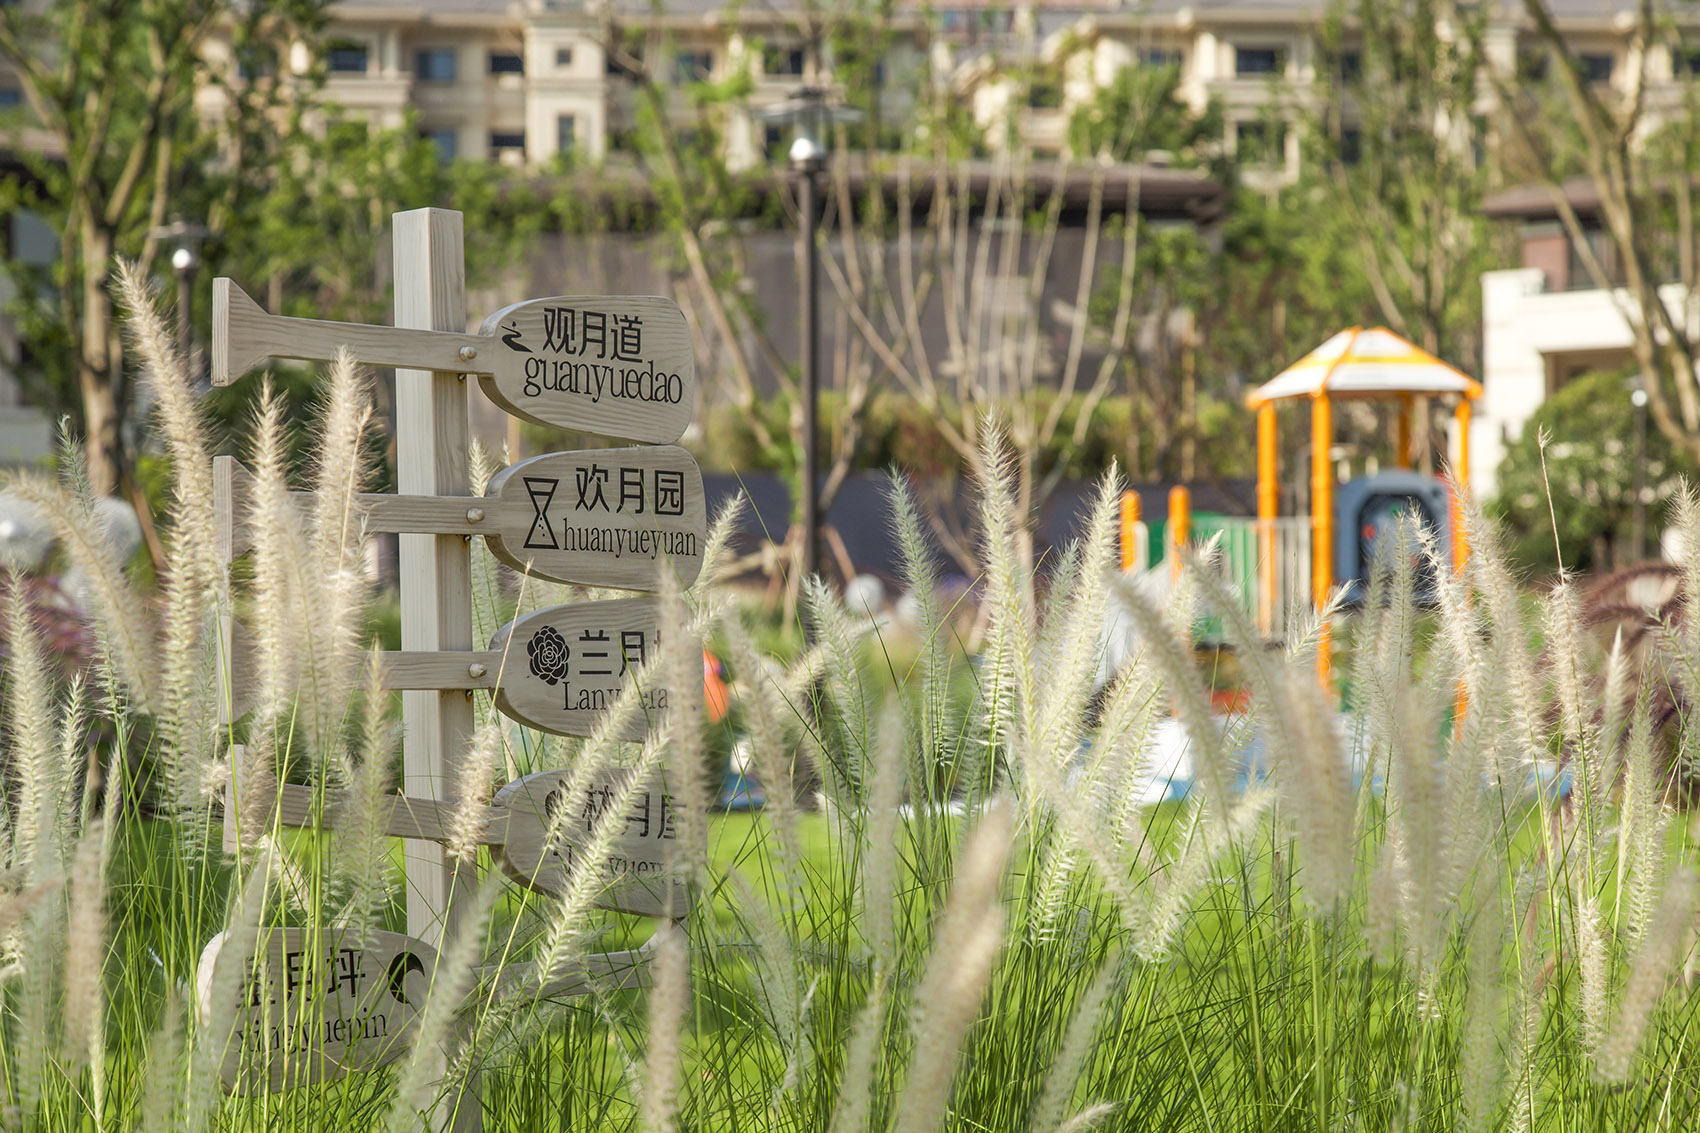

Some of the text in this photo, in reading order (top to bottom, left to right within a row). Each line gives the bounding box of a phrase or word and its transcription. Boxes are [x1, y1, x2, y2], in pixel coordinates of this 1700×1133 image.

[543, 307, 643, 363] 观月道
[523, 356, 683, 404] guanyuedao
[575, 463, 684, 516] 欢月园
[563, 517, 697, 560] huanyueyuan
[578, 629, 670, 678] 兰月
